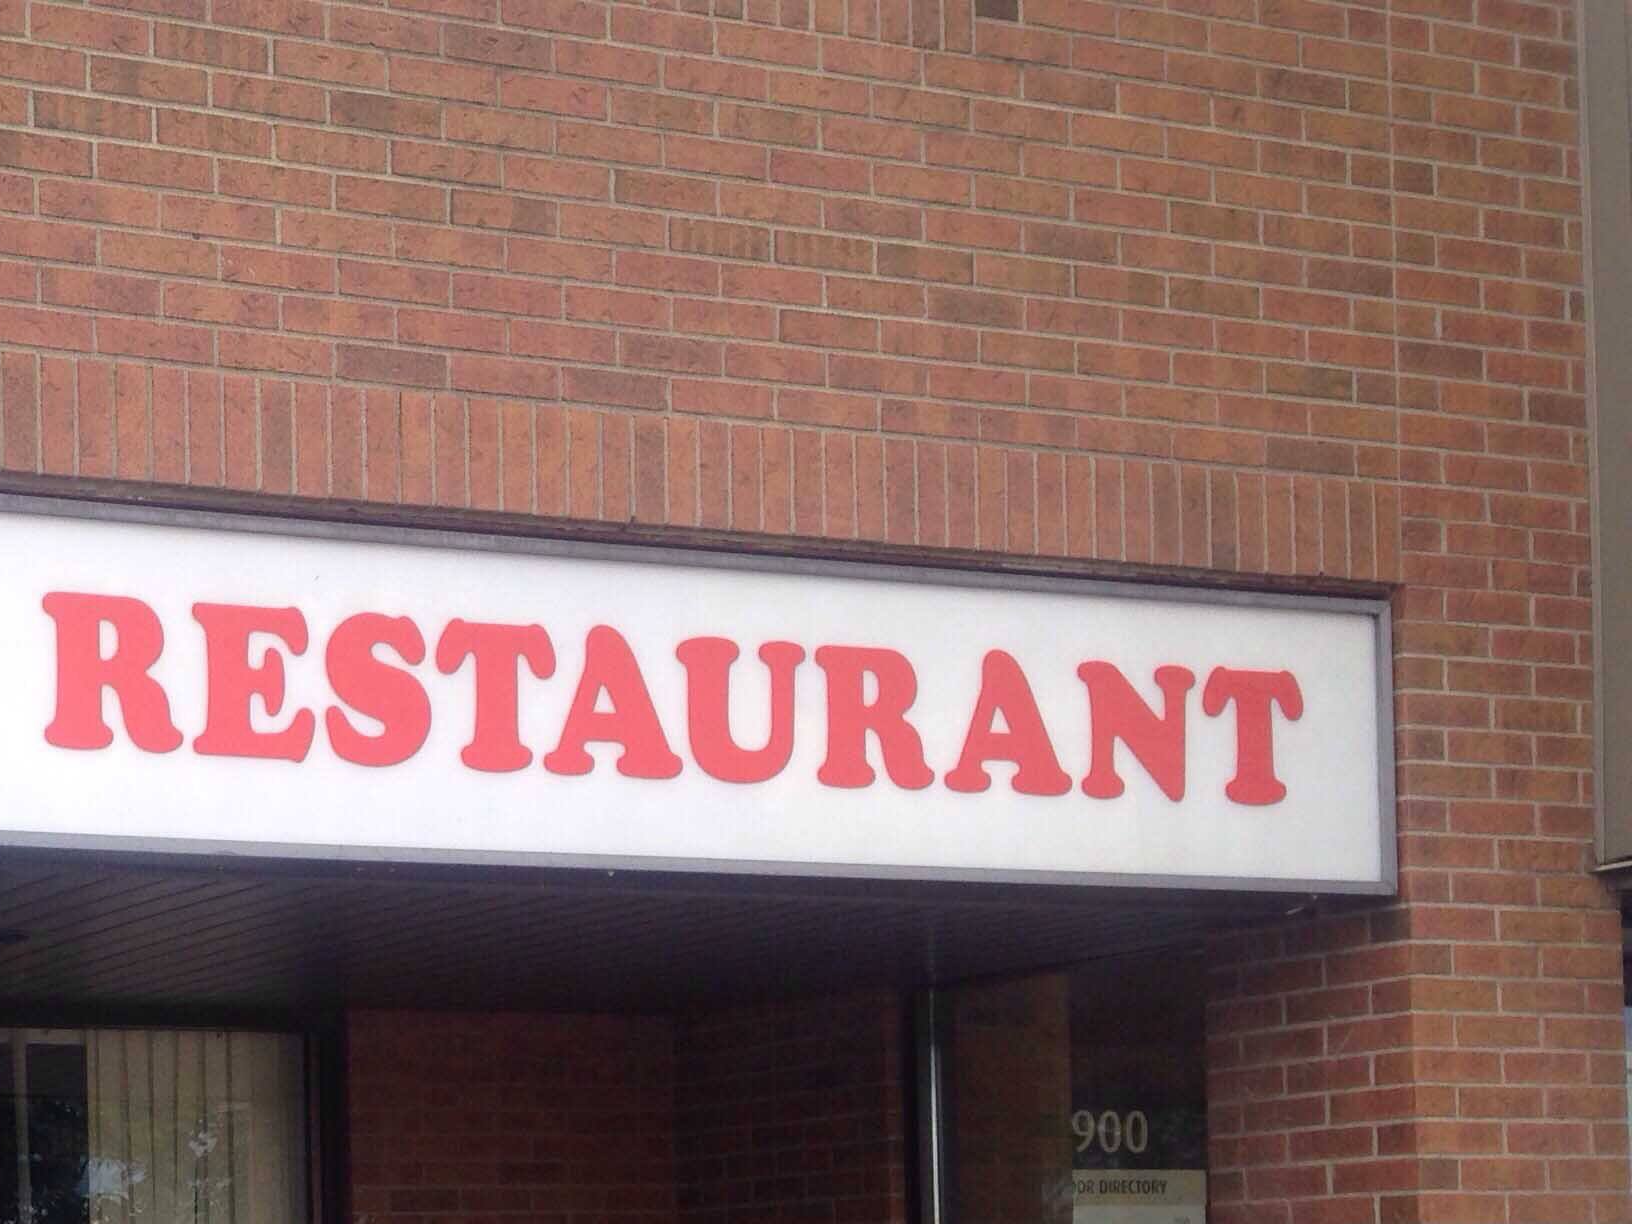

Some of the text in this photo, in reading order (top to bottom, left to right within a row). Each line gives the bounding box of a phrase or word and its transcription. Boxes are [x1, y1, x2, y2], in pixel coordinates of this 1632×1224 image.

[42, 592, 1304, 805] RESTAURANT
[1071, 1109, 1149, 1153] 900
[1099, 1179, 1168, 1196] DIRECTORY
